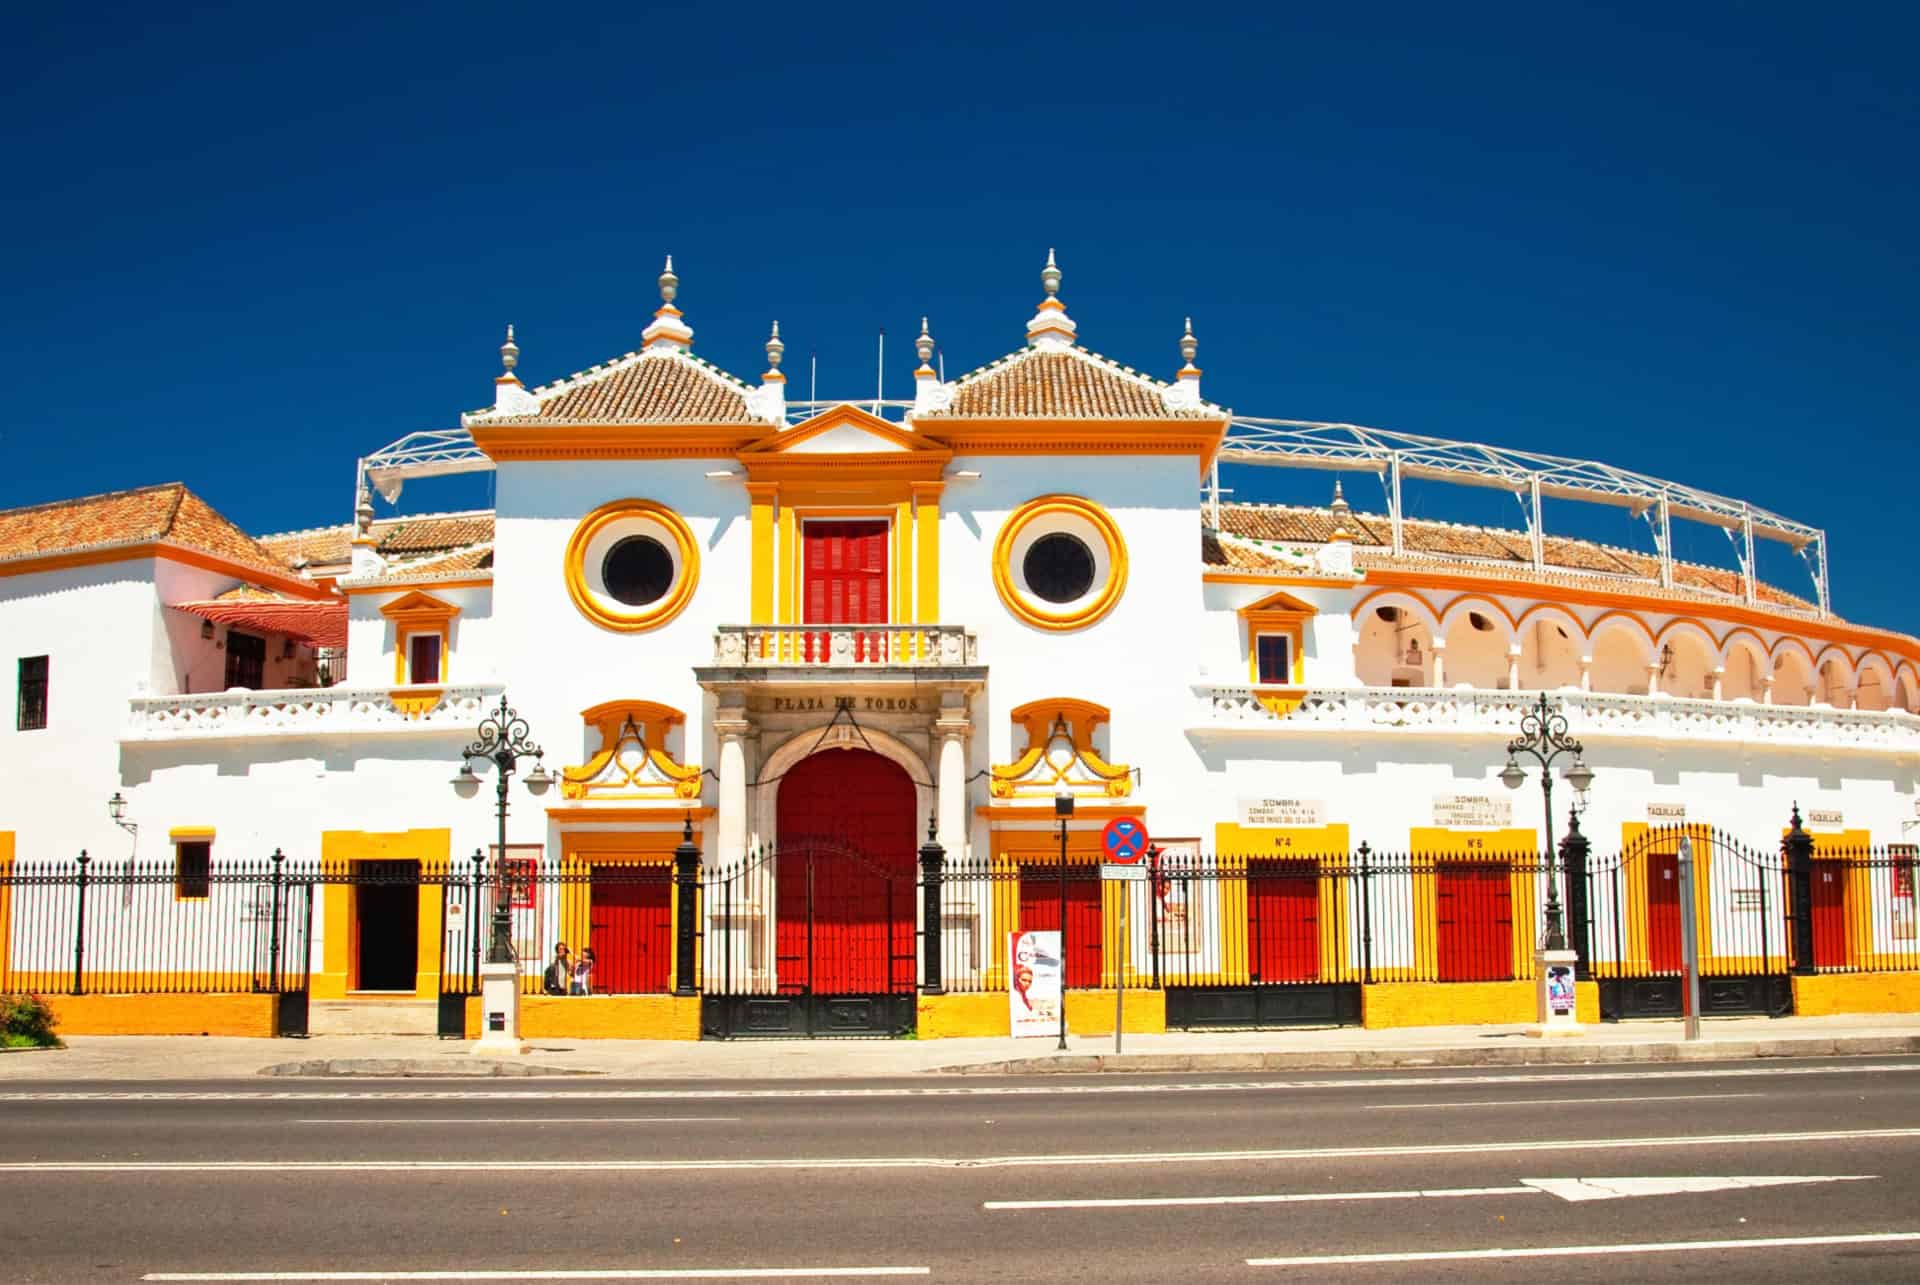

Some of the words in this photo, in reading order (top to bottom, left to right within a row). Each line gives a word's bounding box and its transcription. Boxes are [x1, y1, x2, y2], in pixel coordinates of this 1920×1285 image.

[774, 697, 824, 711] PLAZA
[834, 696, 857, 709] DE
[864, 697, 919, 710] TOROS
[1263, 799, 1301, 808] SOMBRA
[1455, 795, 1489, 804] SOMBRA
[1647, 807, 1685, 817] TAQUILLAS
[1808, 813, 1843, 823] TAQUILLAS
